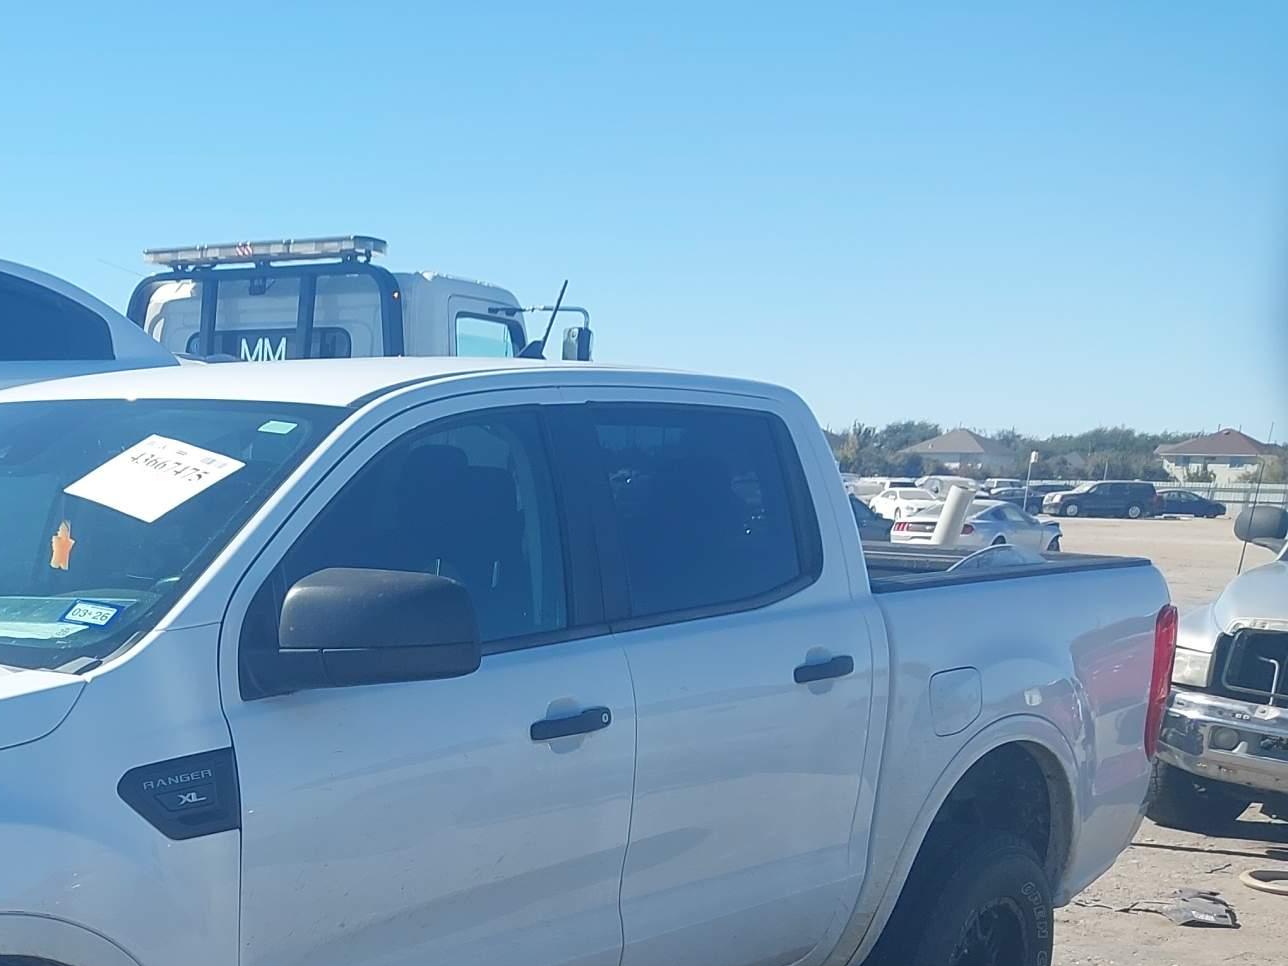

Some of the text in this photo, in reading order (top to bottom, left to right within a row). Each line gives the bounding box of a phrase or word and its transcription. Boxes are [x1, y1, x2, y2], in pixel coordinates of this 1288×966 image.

[240, 337, 287, 361] MM
[143, 768, 213, 791] RANGER
[177, 792, 207, 806] XL
